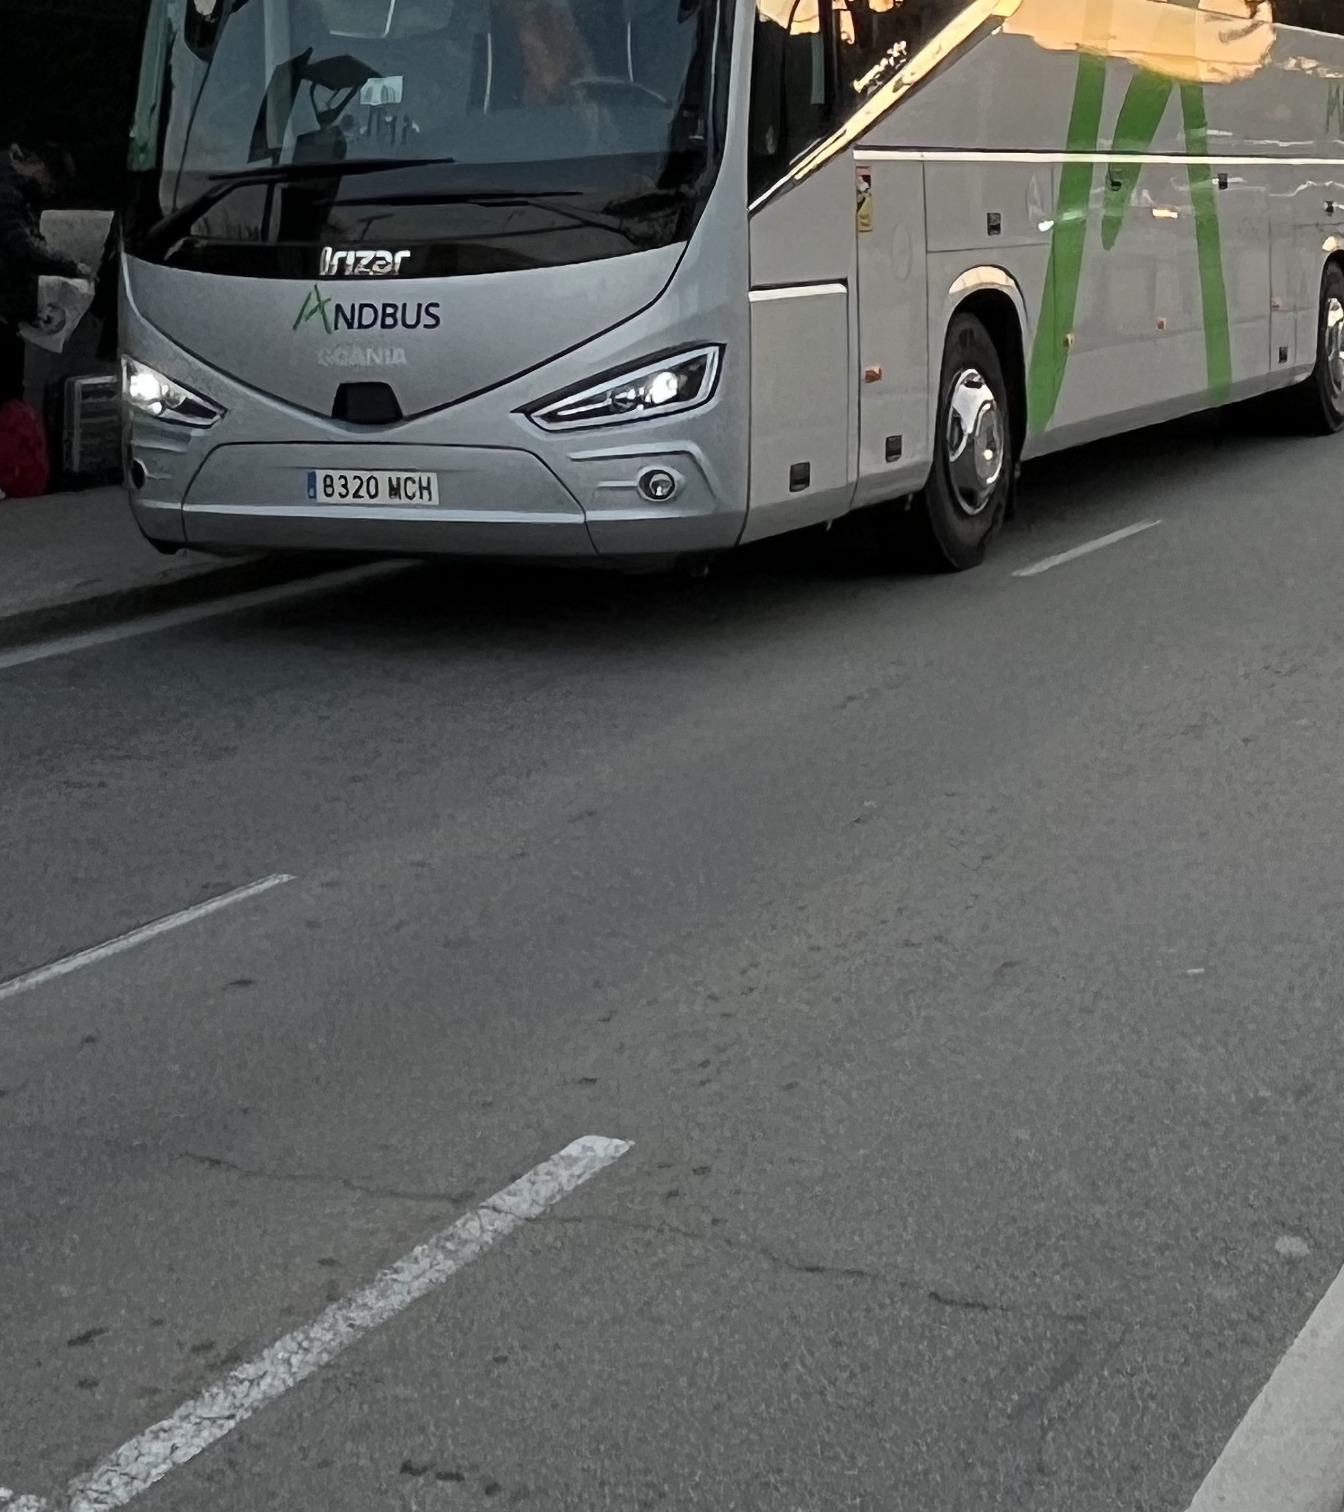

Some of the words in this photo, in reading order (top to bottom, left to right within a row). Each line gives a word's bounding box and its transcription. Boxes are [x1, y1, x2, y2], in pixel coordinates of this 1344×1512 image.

[319, 246, 411, 276] Irizar
[292, 284, 441, 335] ANDBUS
[322, 473, 380, 500] 8320
[387, 475, 433, 502] MCH
